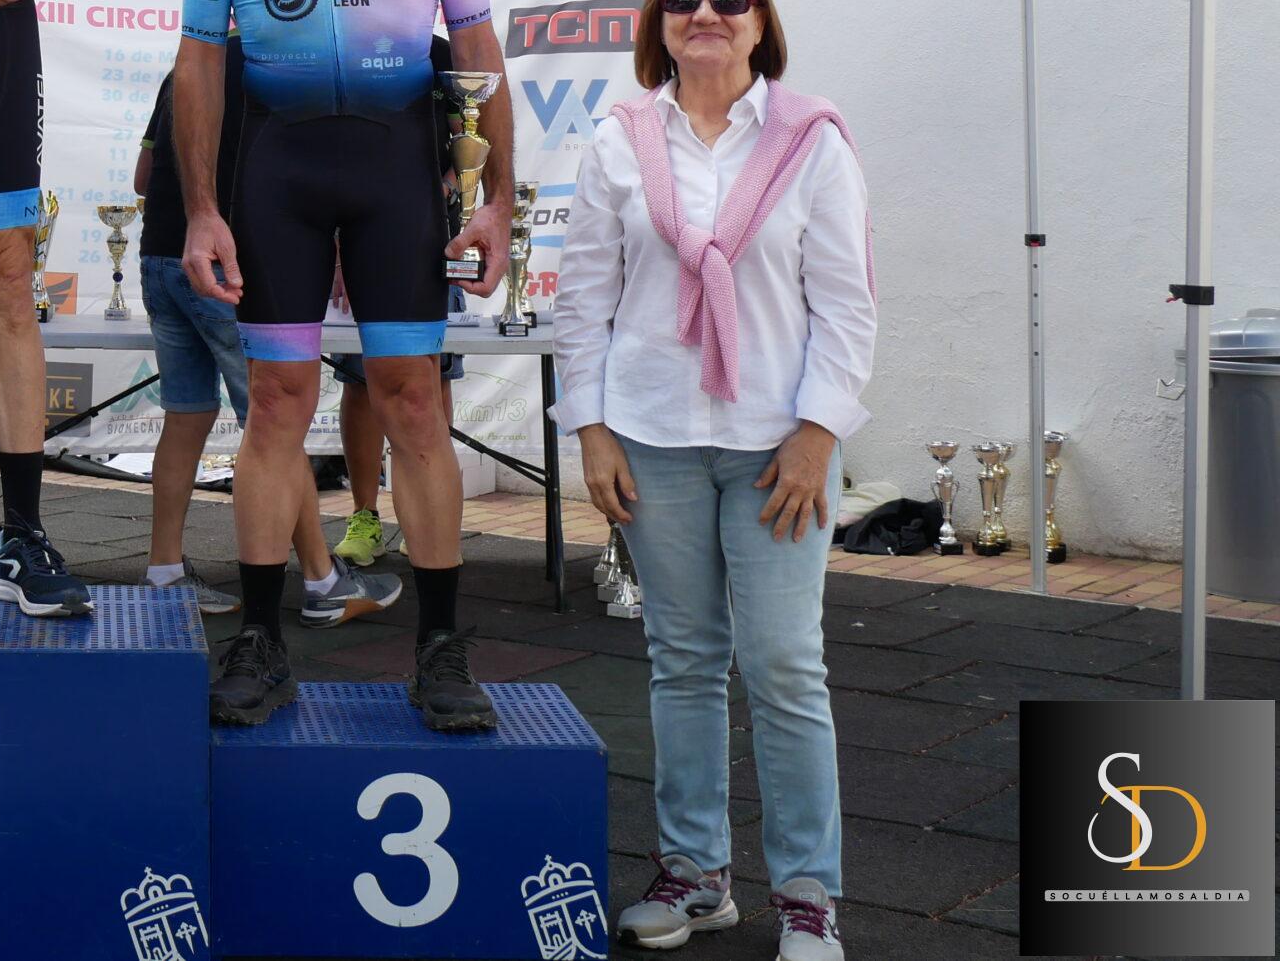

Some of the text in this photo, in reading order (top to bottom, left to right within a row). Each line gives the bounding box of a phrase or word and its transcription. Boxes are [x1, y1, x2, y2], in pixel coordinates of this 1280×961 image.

[86, 5, 179, 31] CIRCU
[514, 7, 641, 48] TCM
[131, 49, 152, 63] de
[361, 56, 404, 70] aqua
[101, 68, 124, 81] 23
[129, 69, 151, 83] de
[128, 90, 149, 103] de
[82, 189, 103, 202] de
[107, 420, 162, 436] BIOMECÁN
[353, 772, 460, 928] 3
